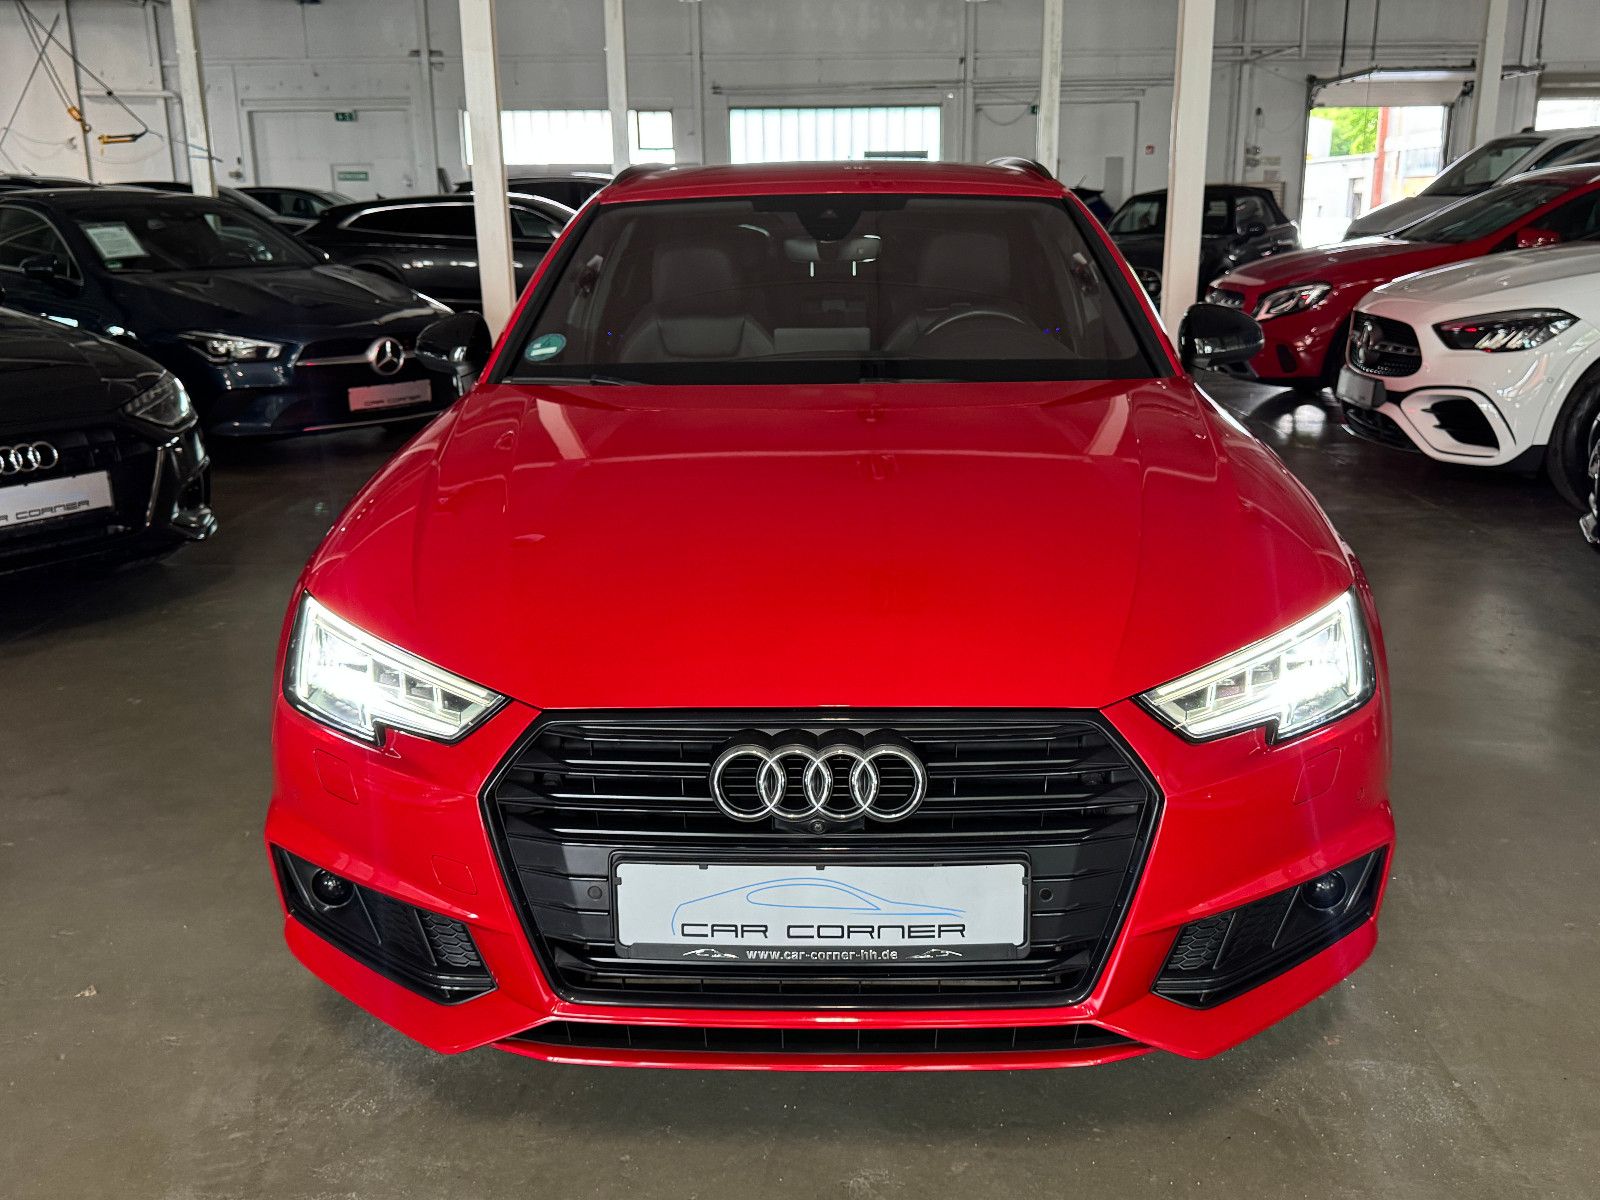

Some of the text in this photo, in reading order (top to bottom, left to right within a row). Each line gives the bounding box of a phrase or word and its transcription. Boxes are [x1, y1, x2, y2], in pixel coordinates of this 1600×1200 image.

[681, 923, 966, 939] CAR CORNER
[746, 949, 898, 960] www.car-corner-hh.de
